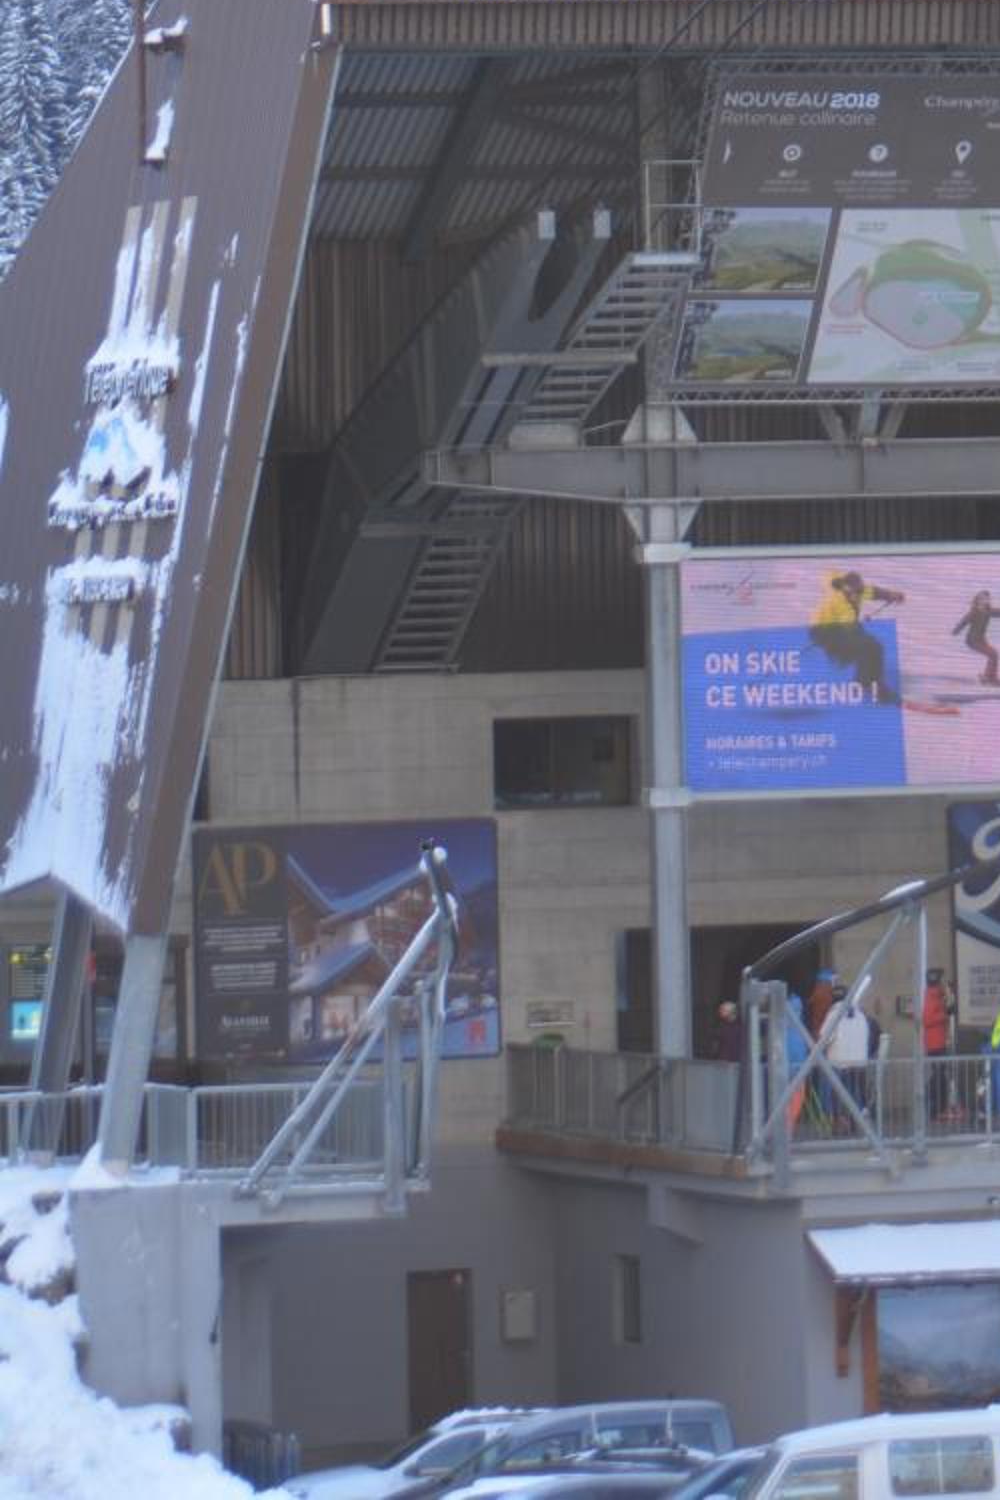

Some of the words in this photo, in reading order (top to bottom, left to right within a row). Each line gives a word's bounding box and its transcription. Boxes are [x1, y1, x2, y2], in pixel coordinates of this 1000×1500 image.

[723, 91, 829, 108] NOUVEAU
[829, 91, 881, 109] 2018
[719, 109, 795, 125] Retenue
[800, 108, 877, 125] collinaire
[705, 652, 739, 675] ON
[745, 650, 801, 674] SKIE
[705, 684, 737, 708] CE
[743, 681, 864, 707] WEEKEND
